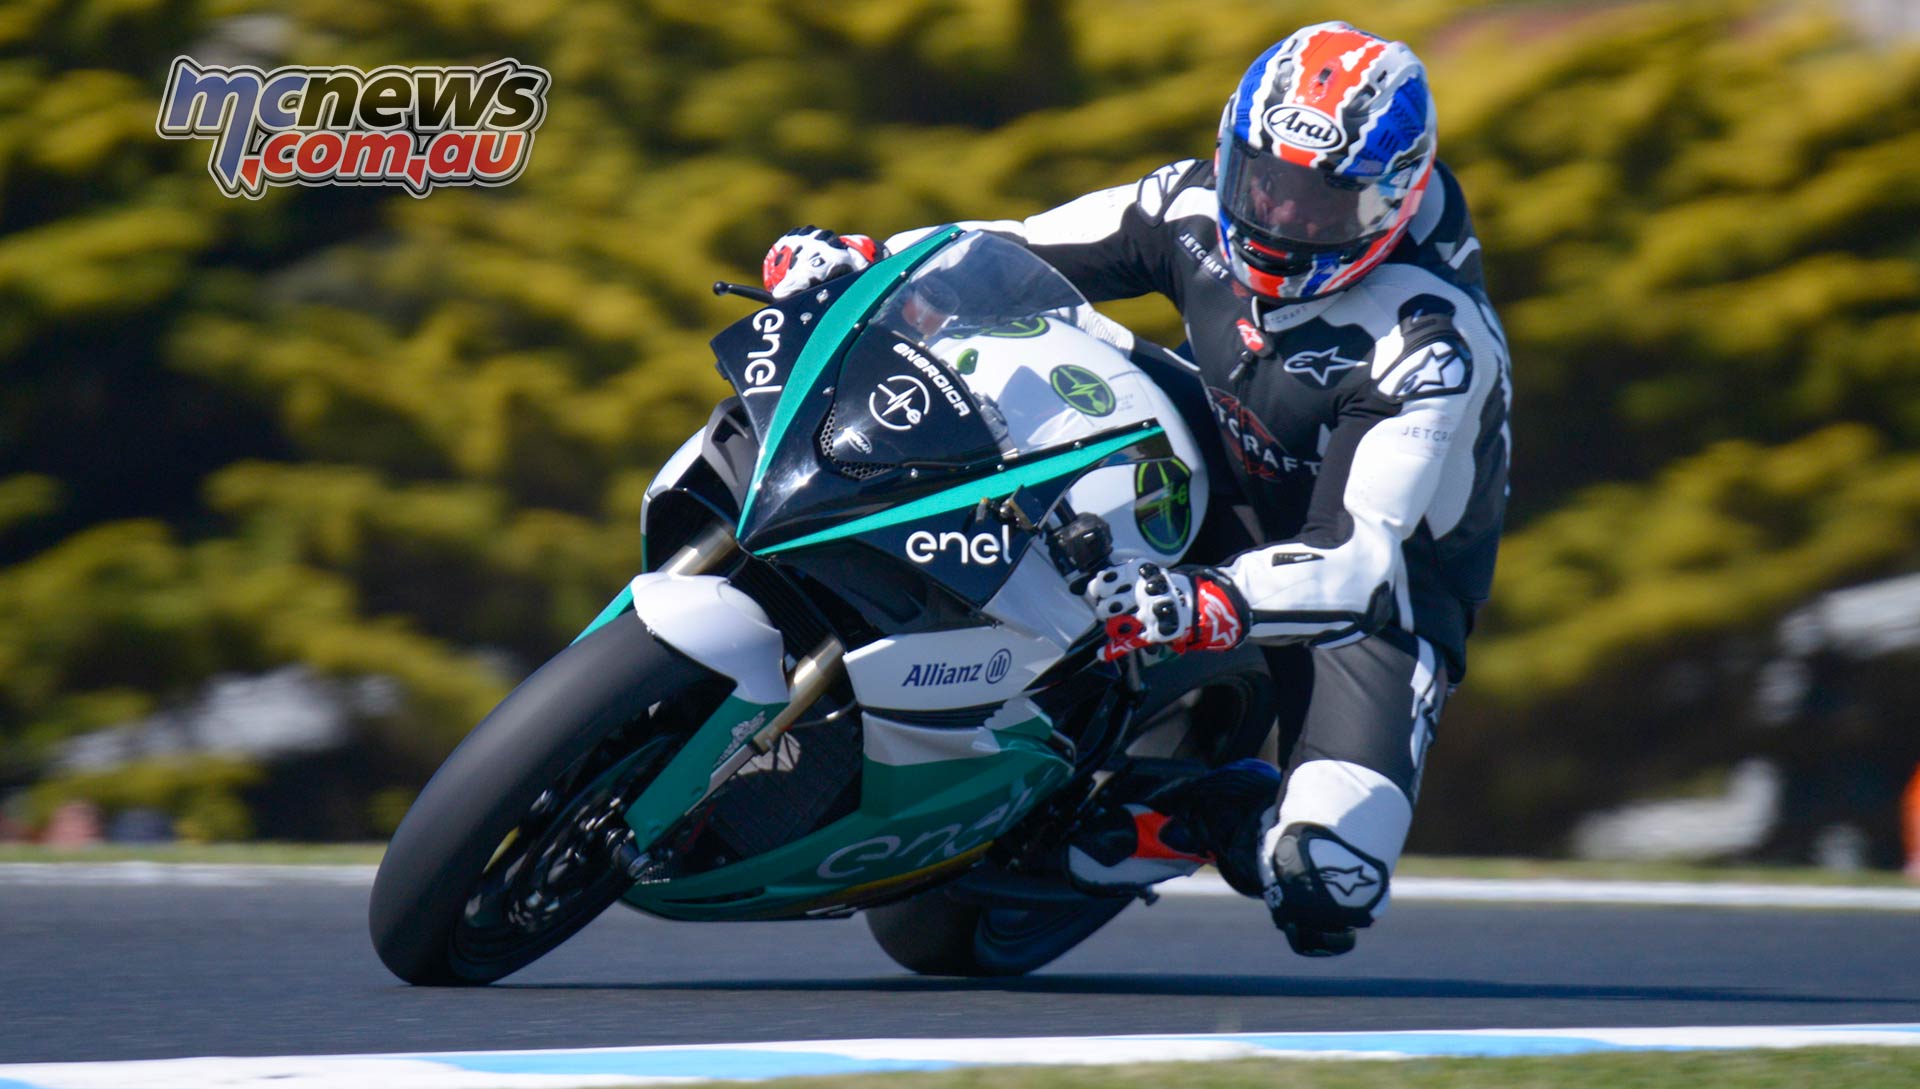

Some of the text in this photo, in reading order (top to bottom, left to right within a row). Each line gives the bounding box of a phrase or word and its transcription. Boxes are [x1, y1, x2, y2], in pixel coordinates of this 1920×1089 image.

[1271, 110, 1335, 142] Arai
[1178, 232, 1230, 280] JETCRAFT
[742, 308, 785, 398] enel
[1207, 394, 1322, 476] TCRAFT
[905, 524, 1013, 565] enel
[901, 661, 984, 687] Allianz
